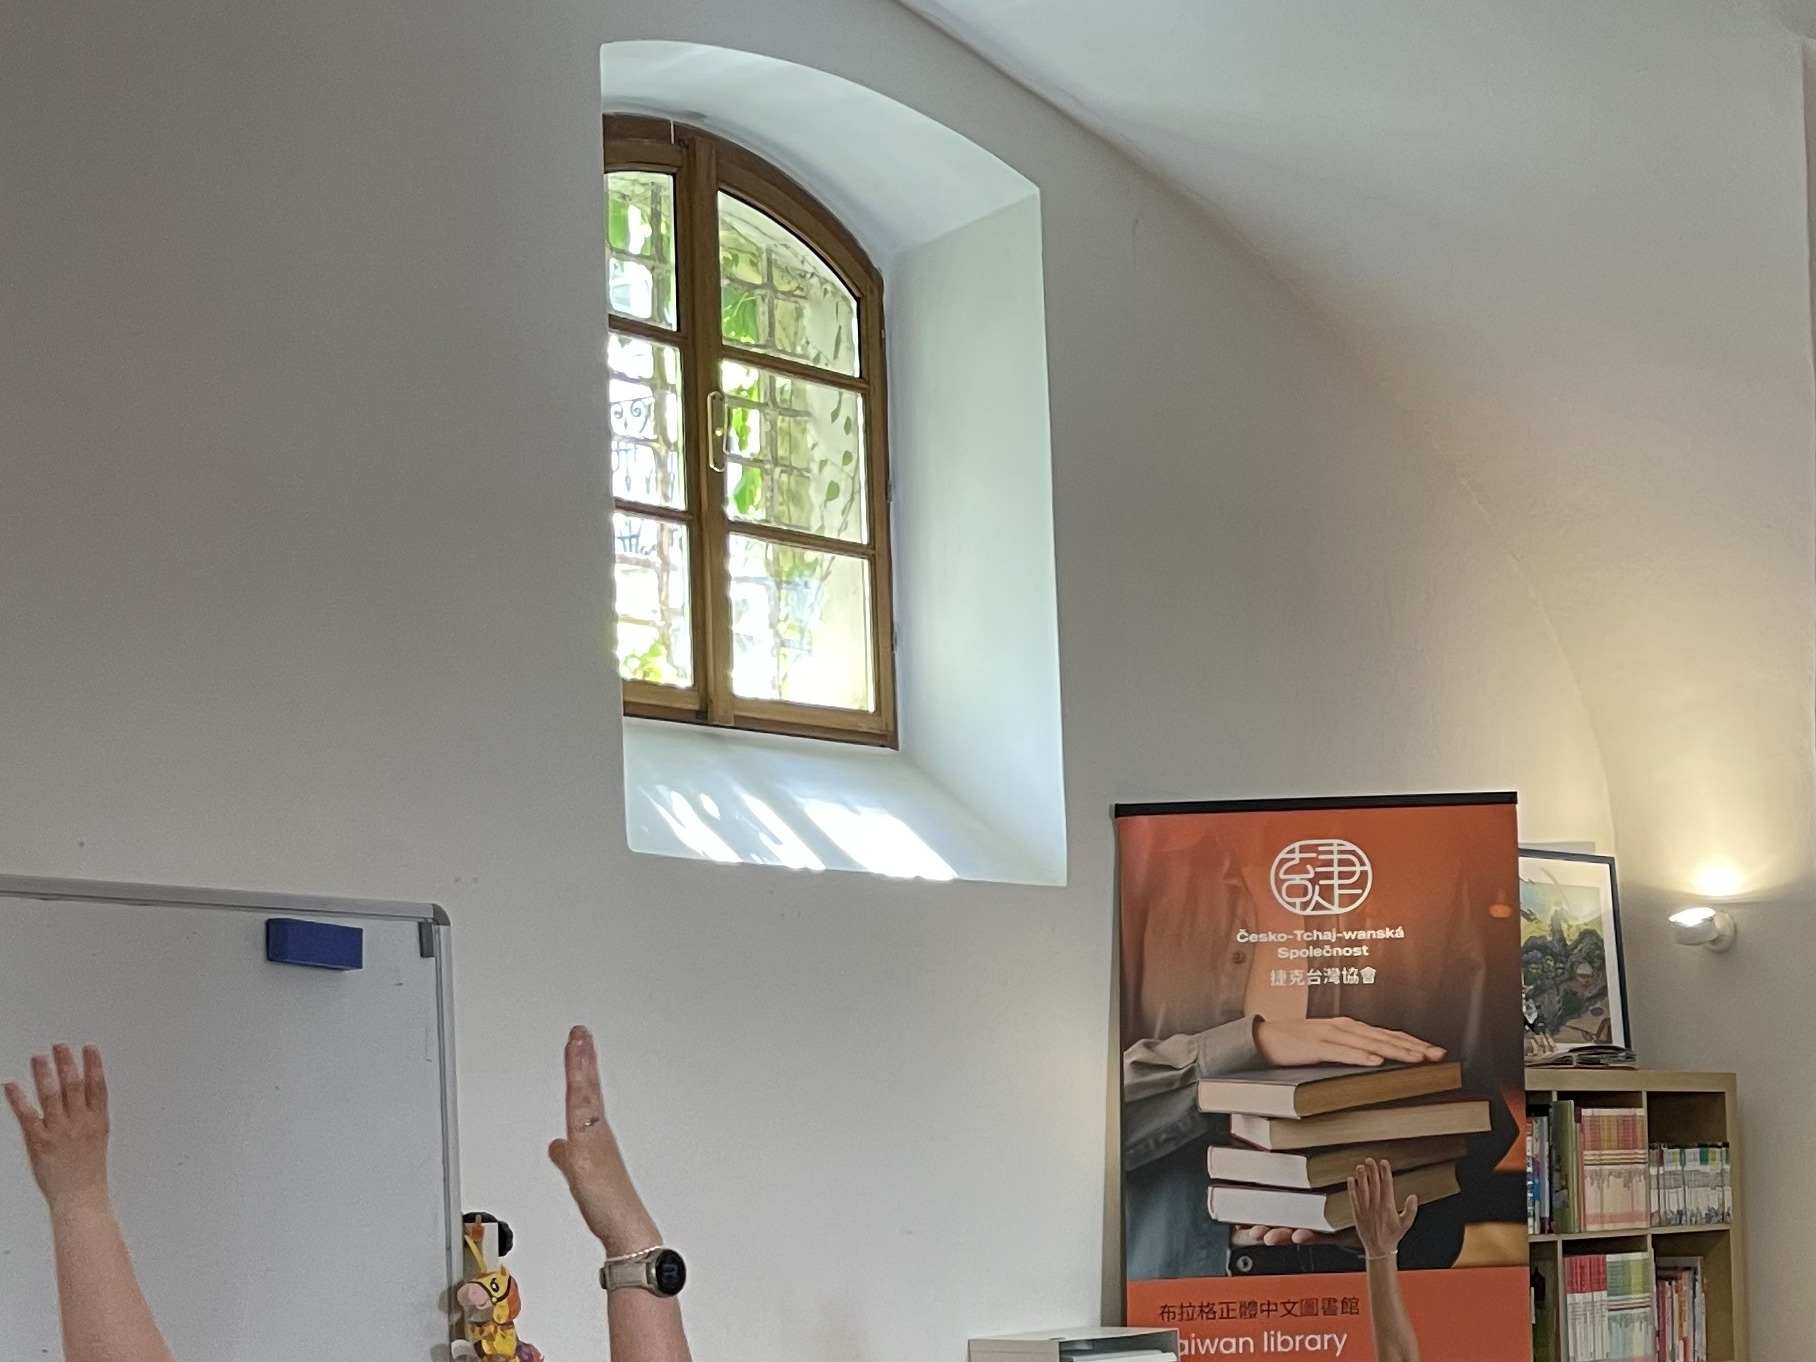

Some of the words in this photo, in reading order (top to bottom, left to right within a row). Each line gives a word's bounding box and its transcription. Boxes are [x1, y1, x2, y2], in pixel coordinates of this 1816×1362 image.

[1236, 926, 1405, 943] Česko-Tchaj-wanská
[1277, 945, 1369, 960] Společnost
[1270, 966, 1377, 986] 捷克台灣協會
[1159, 1297, 1360, 1322] 布拉格正體中文圖書館
[1180, 1332, 1255, 1356] aiwan
[1263, 1330, 1348, 1357] library
